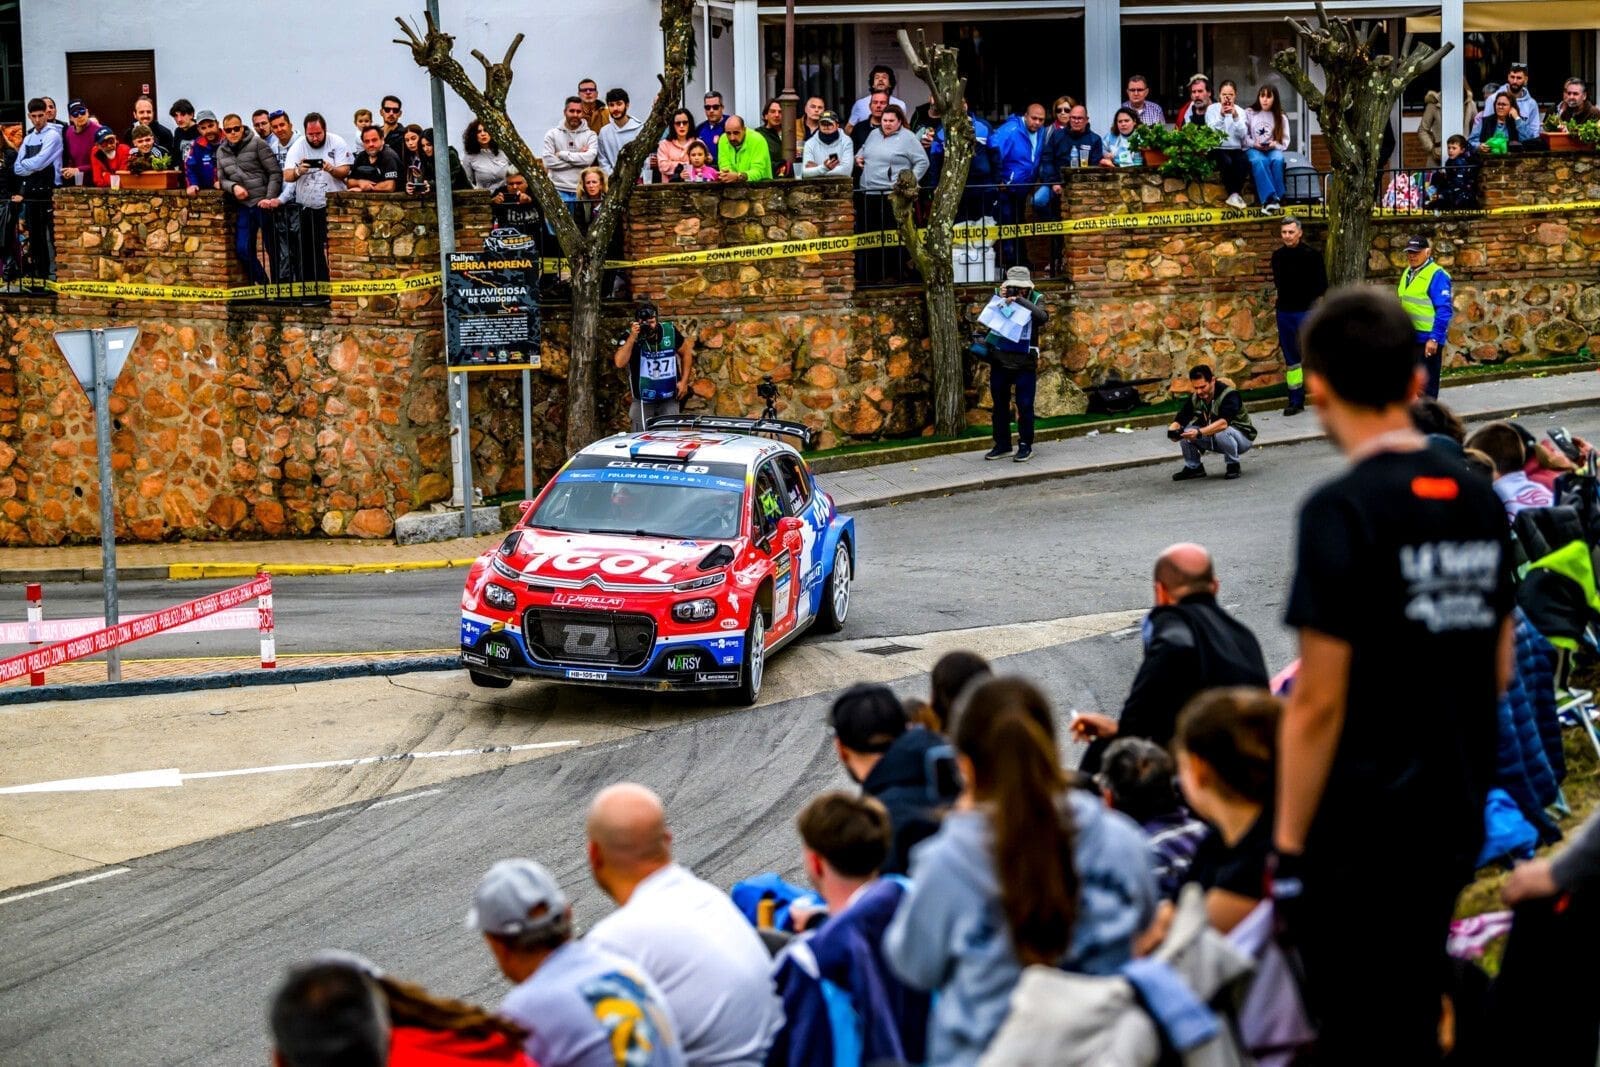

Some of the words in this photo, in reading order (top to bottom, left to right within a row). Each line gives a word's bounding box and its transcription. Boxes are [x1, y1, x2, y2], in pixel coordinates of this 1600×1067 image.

[1024, 222, 1063, 234] PUBLICO
[1073, 220, 1097, 230] ZONA
[1100, 217, 1138, 228] PUBLICO
[1147, 215, 1171, 226] ZONA
[1174, 212, 1212, 224] PUBLICO
[1221, 210, 1245, 220] ZONA
[706, 250, 731, 260] ZONA
[734, 246, 774, 258] PUBLICO
[782, 242, 807, 254] ZONA
[810, 238, 848, 250] PUBLICO
[856, 236, 876, 246] ZONA
[450, 254, 474, 263] Rallye
[450, 262, 486, 270] SIERRA
[488, 260, 532, 269] MORENA
[552, 262, 570, 270] ZON
[115, 286, 136, 295] ZONA
[135, 287, 164, 297] PUBLICO
[232, 288, 256, 297] ZONA
[340, 284, 360, 293] ZONA
[362, 282, 396, 292] PUBLICO
[404, 276, 430, 289] ZONA
[458, 286, 527, 297] VILLAVICIOSA
[606, 460, 683, 472] ORECA
[28, 648, 50, 672] PUBLICO
[52, 644, 66, 664] ZONA
[68, 634, 94, 659] PROHIBIDO
[94, 628, 116, 650] PUBLICO
[118, 624, 132, 644] ZONA
[132, 614, 158, 638] PROHIBIDO
[486, 642, 510, 659] MARSY
[667, 656, 701, 670] MARSY
